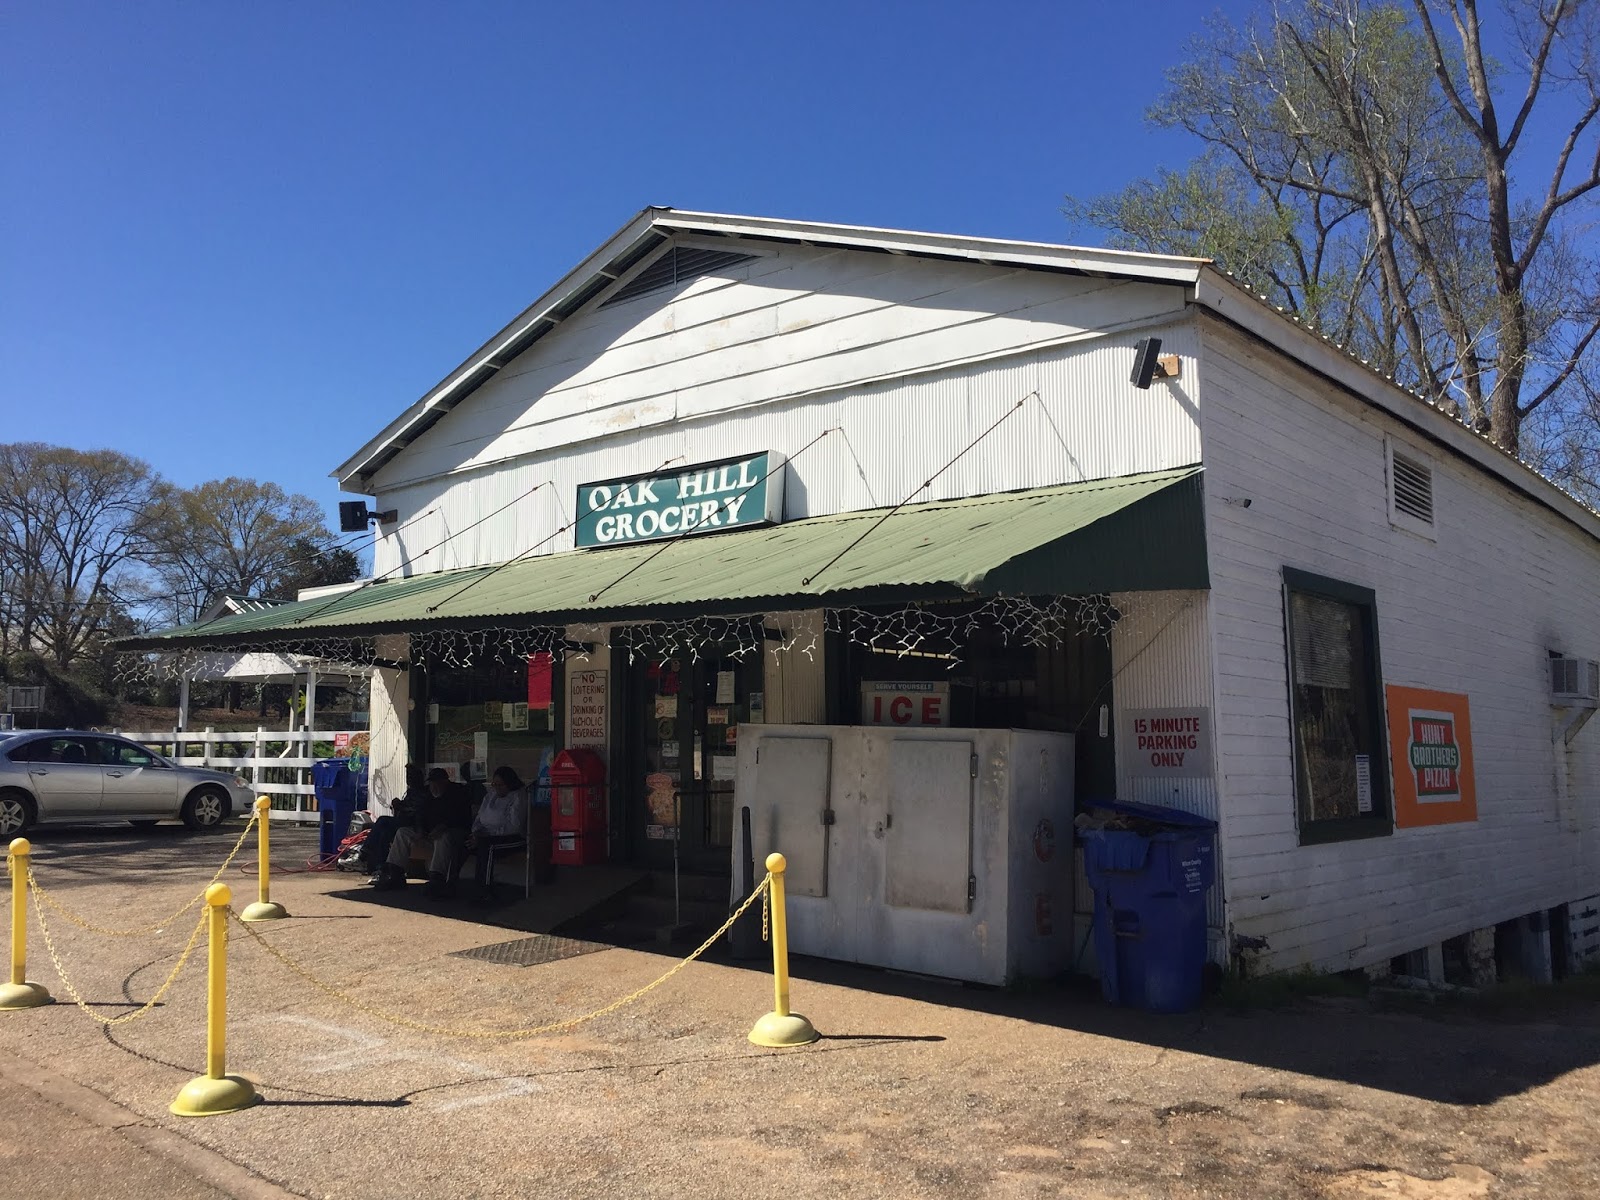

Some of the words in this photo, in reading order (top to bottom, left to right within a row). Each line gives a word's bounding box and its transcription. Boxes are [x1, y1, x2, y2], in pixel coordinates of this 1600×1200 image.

[589, 478, 659, 512] OAK
[676, 461, 758, 500] HILL
[595, 494, 747, 542] GROCERY
[582, 674, 595, 683] NO
[572, 705, 597, 714] DRINKING
[597, 705, 605, 714] OF
[873, 696, 941, 724] ICE
[572, 728, 604, 738] BEVERAGES
[1134, 719, 1147, 733] 15
[1150, 717, 1200, 732] MINUTE
[1138, 734, 1197, 750] PARKING
[1421, 724, 1445, 745] HUNT
[1151, 752, 1185, 767] ONLY
[1413, 746, 1457, 766] BROTHERS
[1424, 767, 1450, 788] PIZZA
